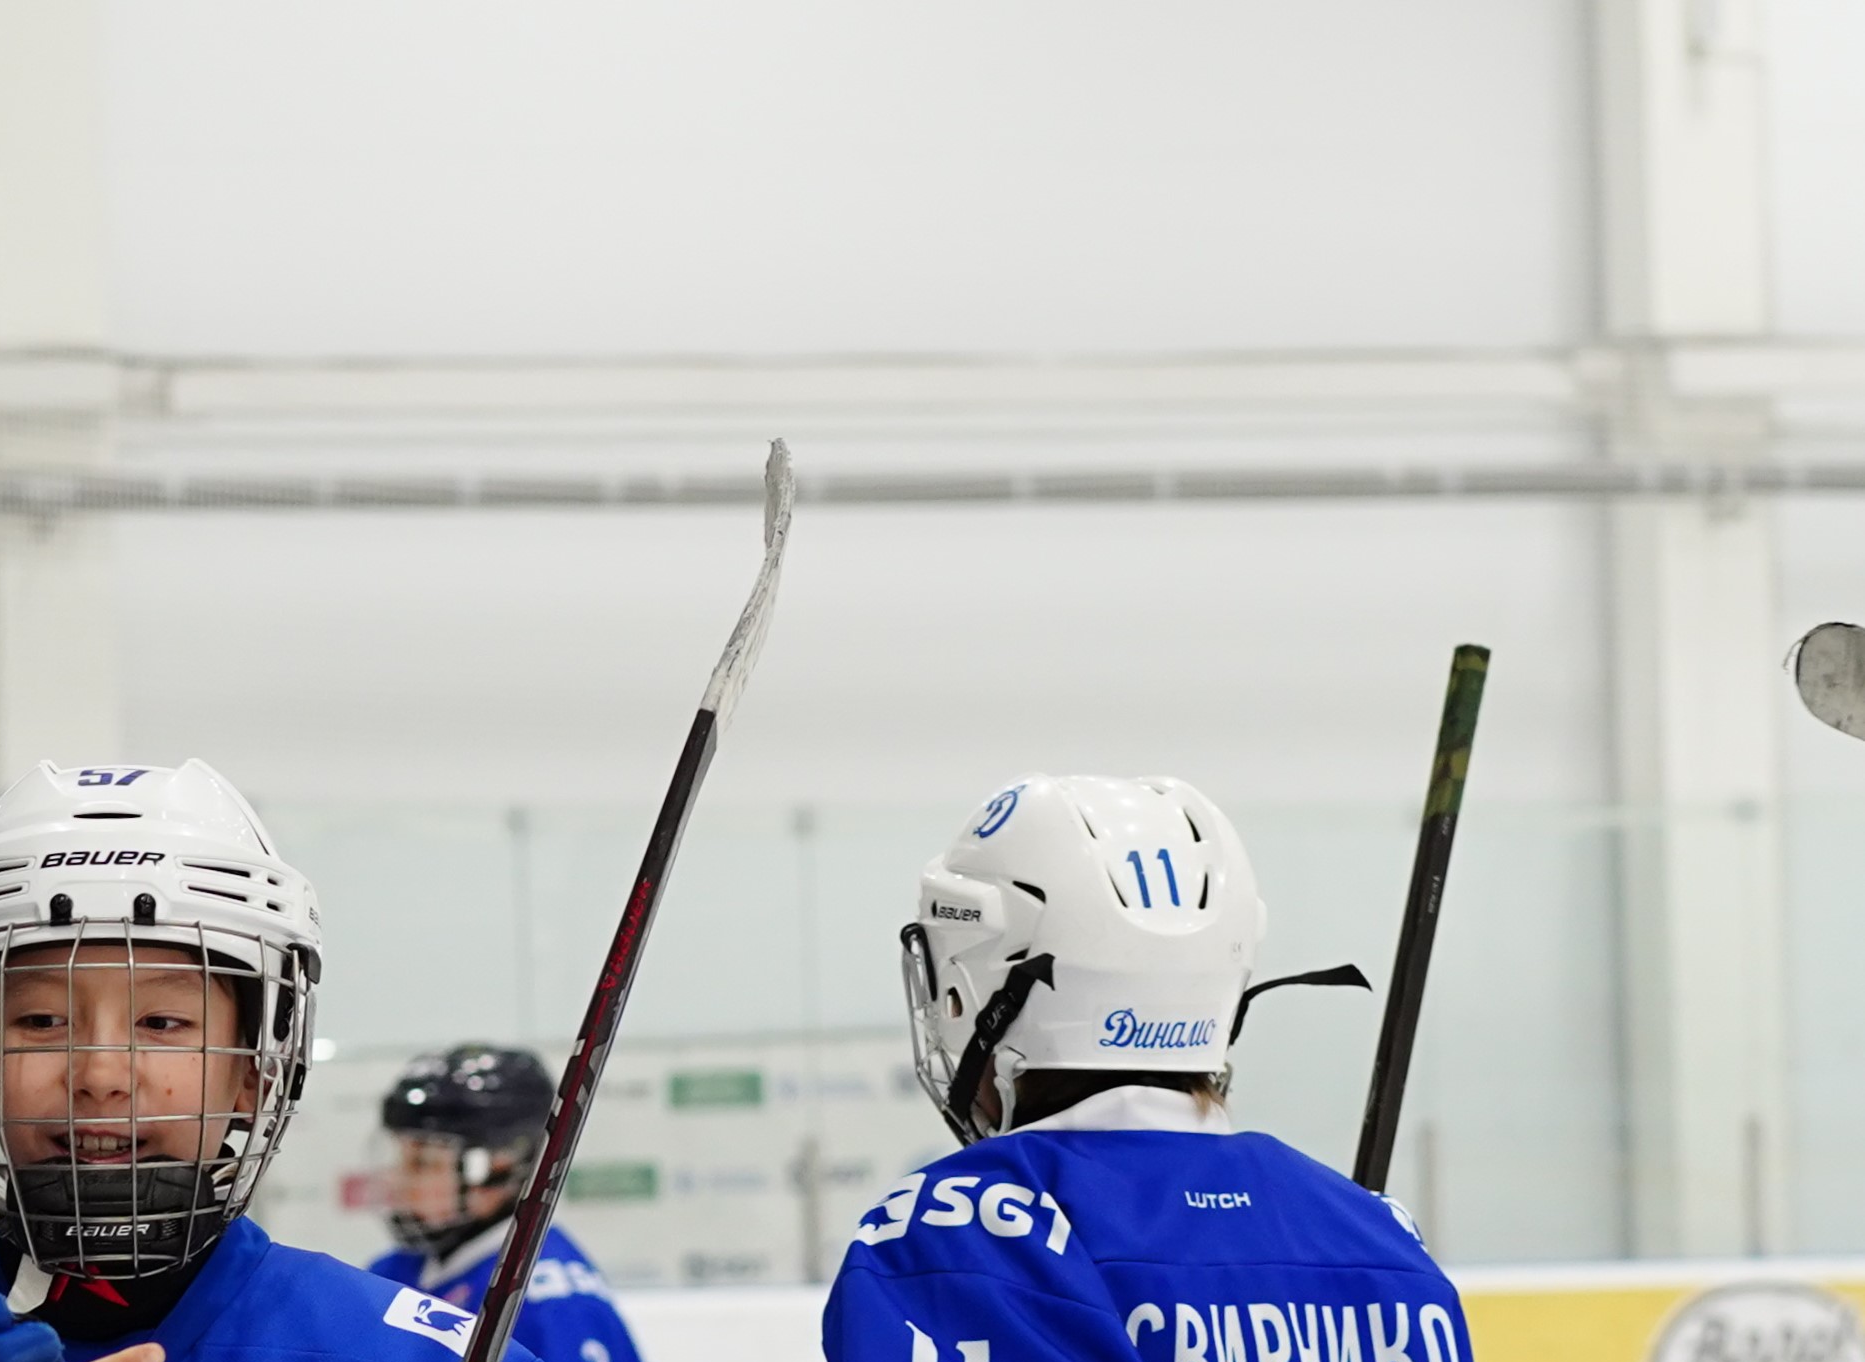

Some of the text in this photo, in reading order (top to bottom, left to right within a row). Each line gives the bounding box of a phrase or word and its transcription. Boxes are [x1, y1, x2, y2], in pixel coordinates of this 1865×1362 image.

[78, 768, 151, 787] 57
[40, 850, 166, 868] BAUER
[1126, 848, 1181, 909] 11
[938, 906, 982, 922] BAUER
[1099, 1008, 1218, 1050] Динамо
[1185, 1190, 1252, 1209] LUTCH
[921, 1176, 1073, 1256] SGT
[65, 1223, 151, 1238] BAUER
